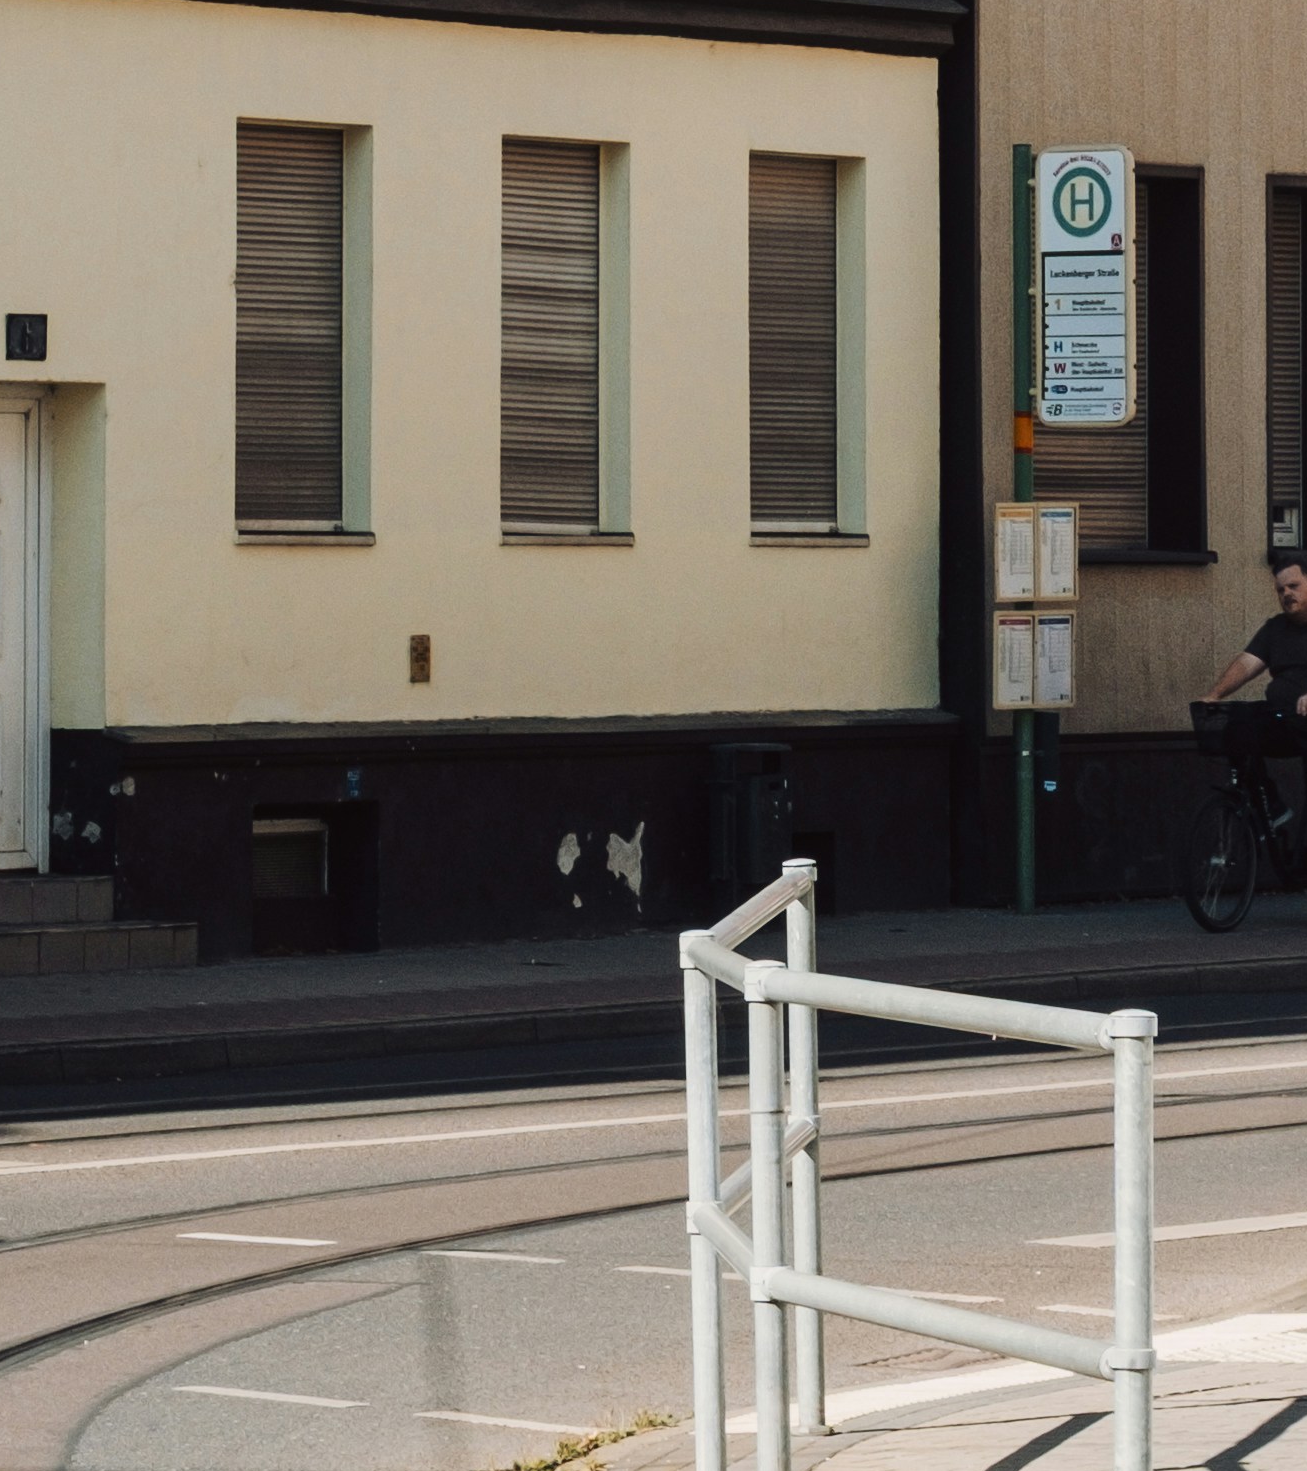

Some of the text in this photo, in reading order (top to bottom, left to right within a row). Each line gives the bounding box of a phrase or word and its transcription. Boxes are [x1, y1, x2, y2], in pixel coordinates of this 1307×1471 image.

[1070, 183, 1094, 221] H
[1055, 299, 1061, 310] 1
[1054, 341, 1063, 353] H
[1054, 363, 1067, 374] W
